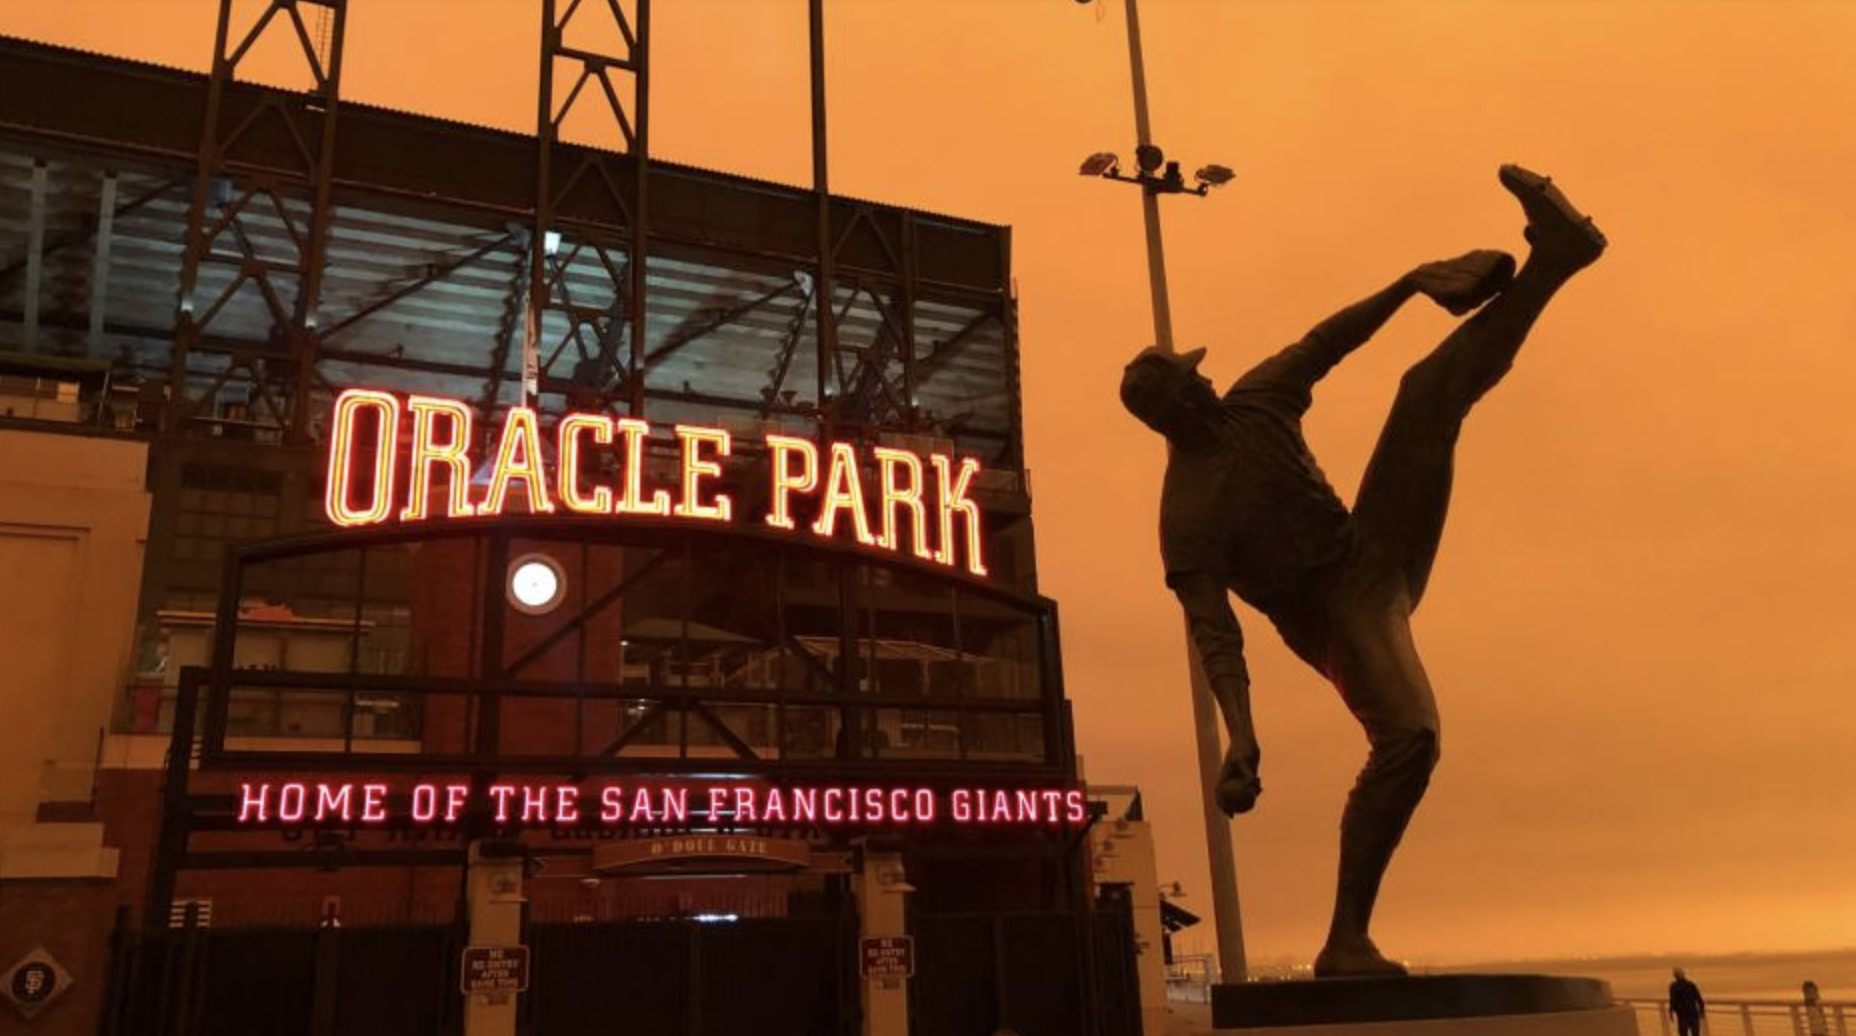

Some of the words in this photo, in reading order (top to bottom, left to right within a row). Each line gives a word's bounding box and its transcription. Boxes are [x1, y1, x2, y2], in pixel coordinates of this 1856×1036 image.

[325, 379, 732, 528] ORACLE
[765, 433, 988, 577] PARK
[239, 783, 387, 822] HOME
[412, 784, 468, 822] OF
[489, 785, 579, 822] THE
[601, 786, 688, 822] SAN
[708, 787, 934, 822] FRANCISCO
[953, 790, 1085, 823] GIANTS
[725, 838, 767, 854] GATE
